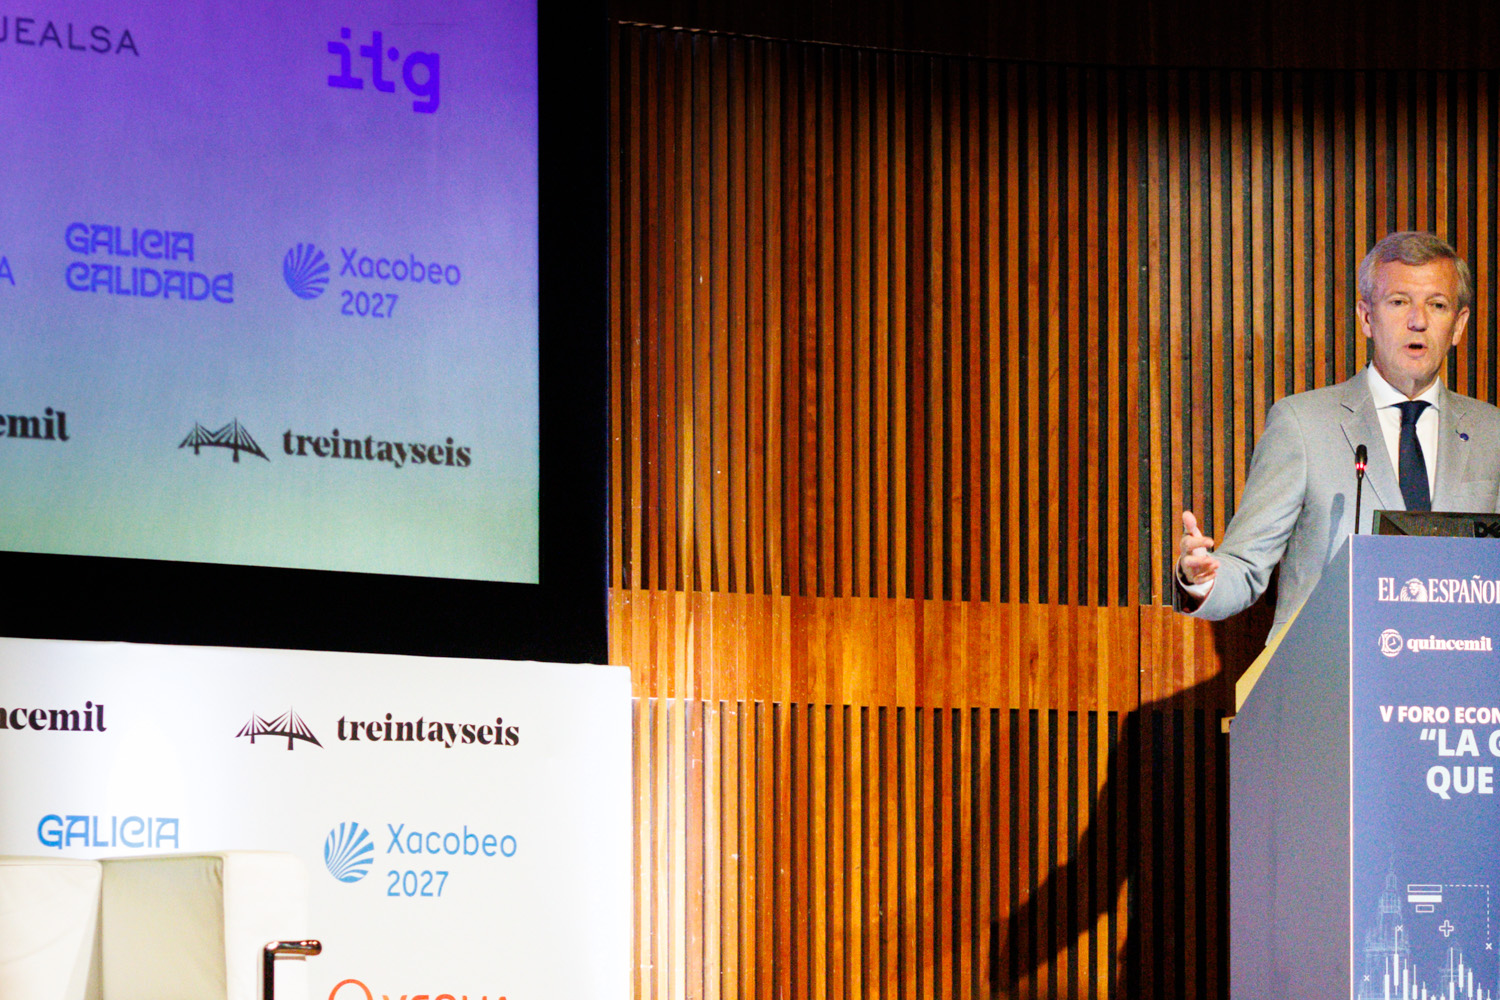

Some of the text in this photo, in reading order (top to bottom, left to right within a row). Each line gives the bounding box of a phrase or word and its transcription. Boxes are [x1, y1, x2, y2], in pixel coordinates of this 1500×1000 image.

[65, 222, 194, 262] GALICIA
[65, 261, 234, 304] CALIDADE
[340, 247, 461, 286] Xacobeo
[341, 290, 399, 319] 2027
[282, 428, 471, 469] treintayseis
[1378, 577, 1399, 602] EL
[1407, 635, 1493, 653] quincemil
[336, 712, 520, 748] treintayseis
[1379, 705, 1394, 723] V
[1398, 705, 1450, 723] FORO
[1426, 766, 1494, 800] QUE
[37, 814, 180, 849] GALICIA
[386, 823, 518, 858] Xacobeo
[387, 870, 449, 897] 2027
